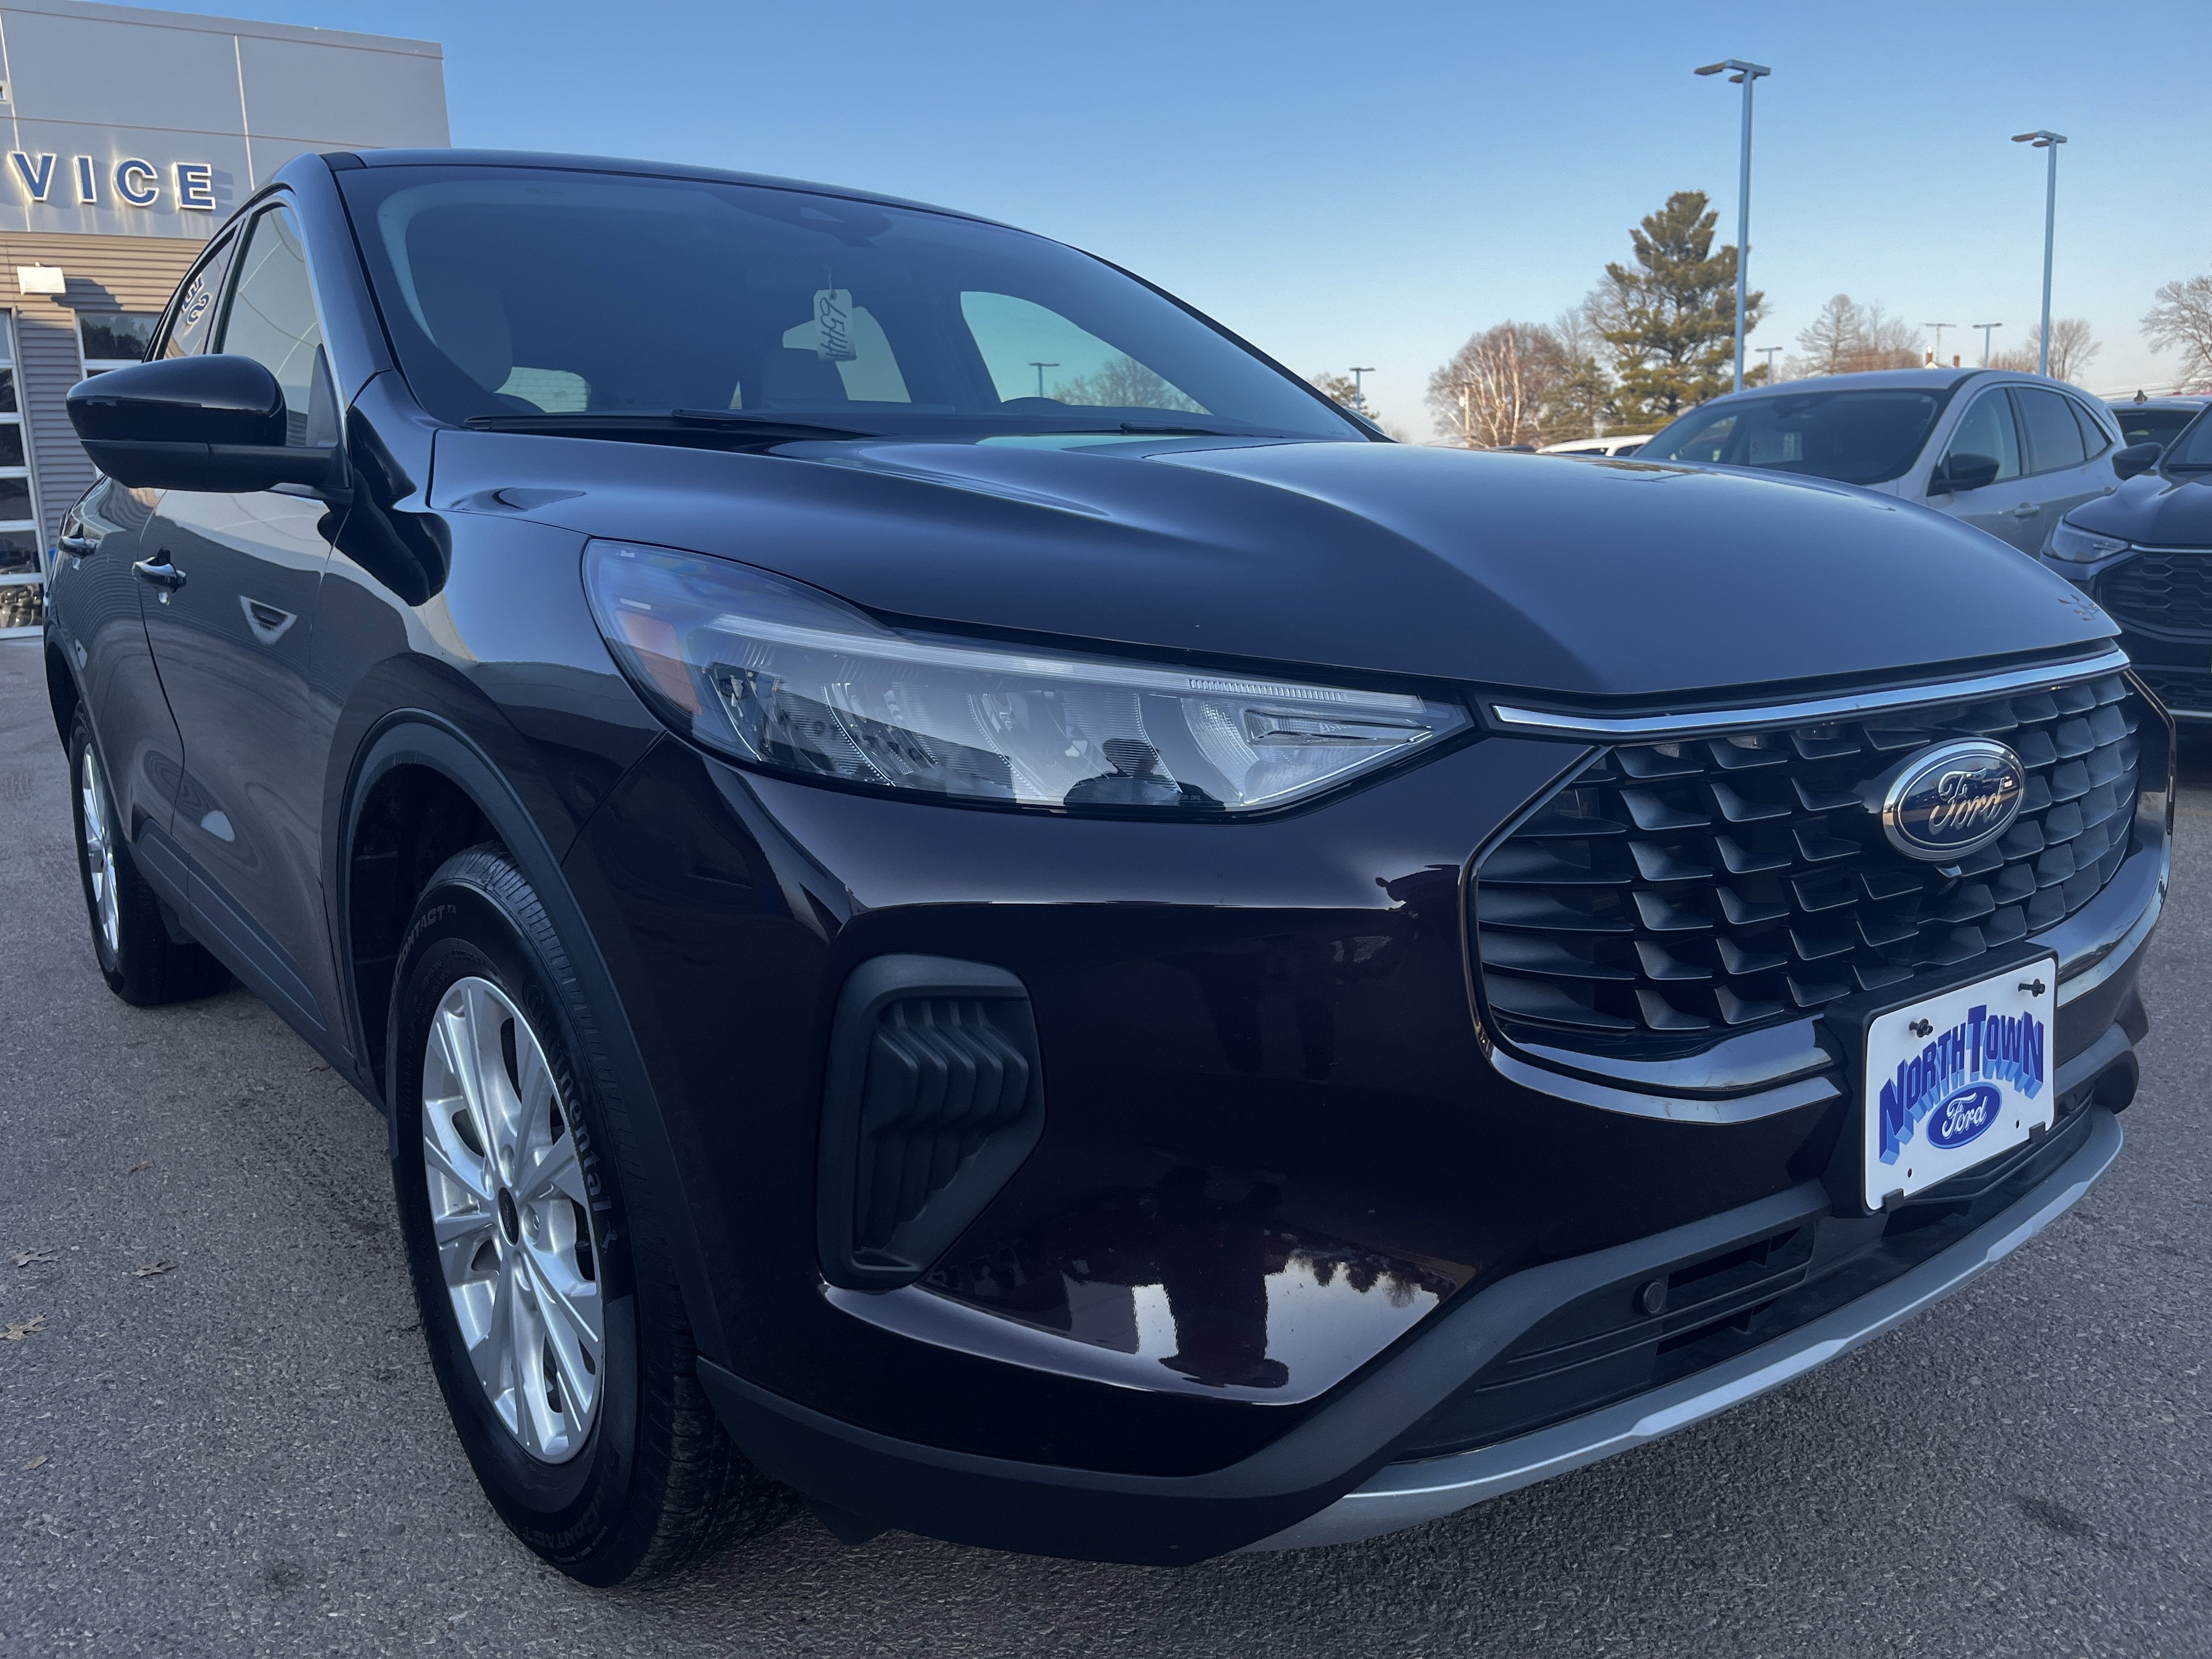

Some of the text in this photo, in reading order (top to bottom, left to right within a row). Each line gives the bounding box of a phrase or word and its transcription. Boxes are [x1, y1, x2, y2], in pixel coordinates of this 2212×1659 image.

[8, 151, 216, 211] VICE
[1928, 768, 2006, 836] Ford
[1941, 1091, 1988, 1139] Ford
